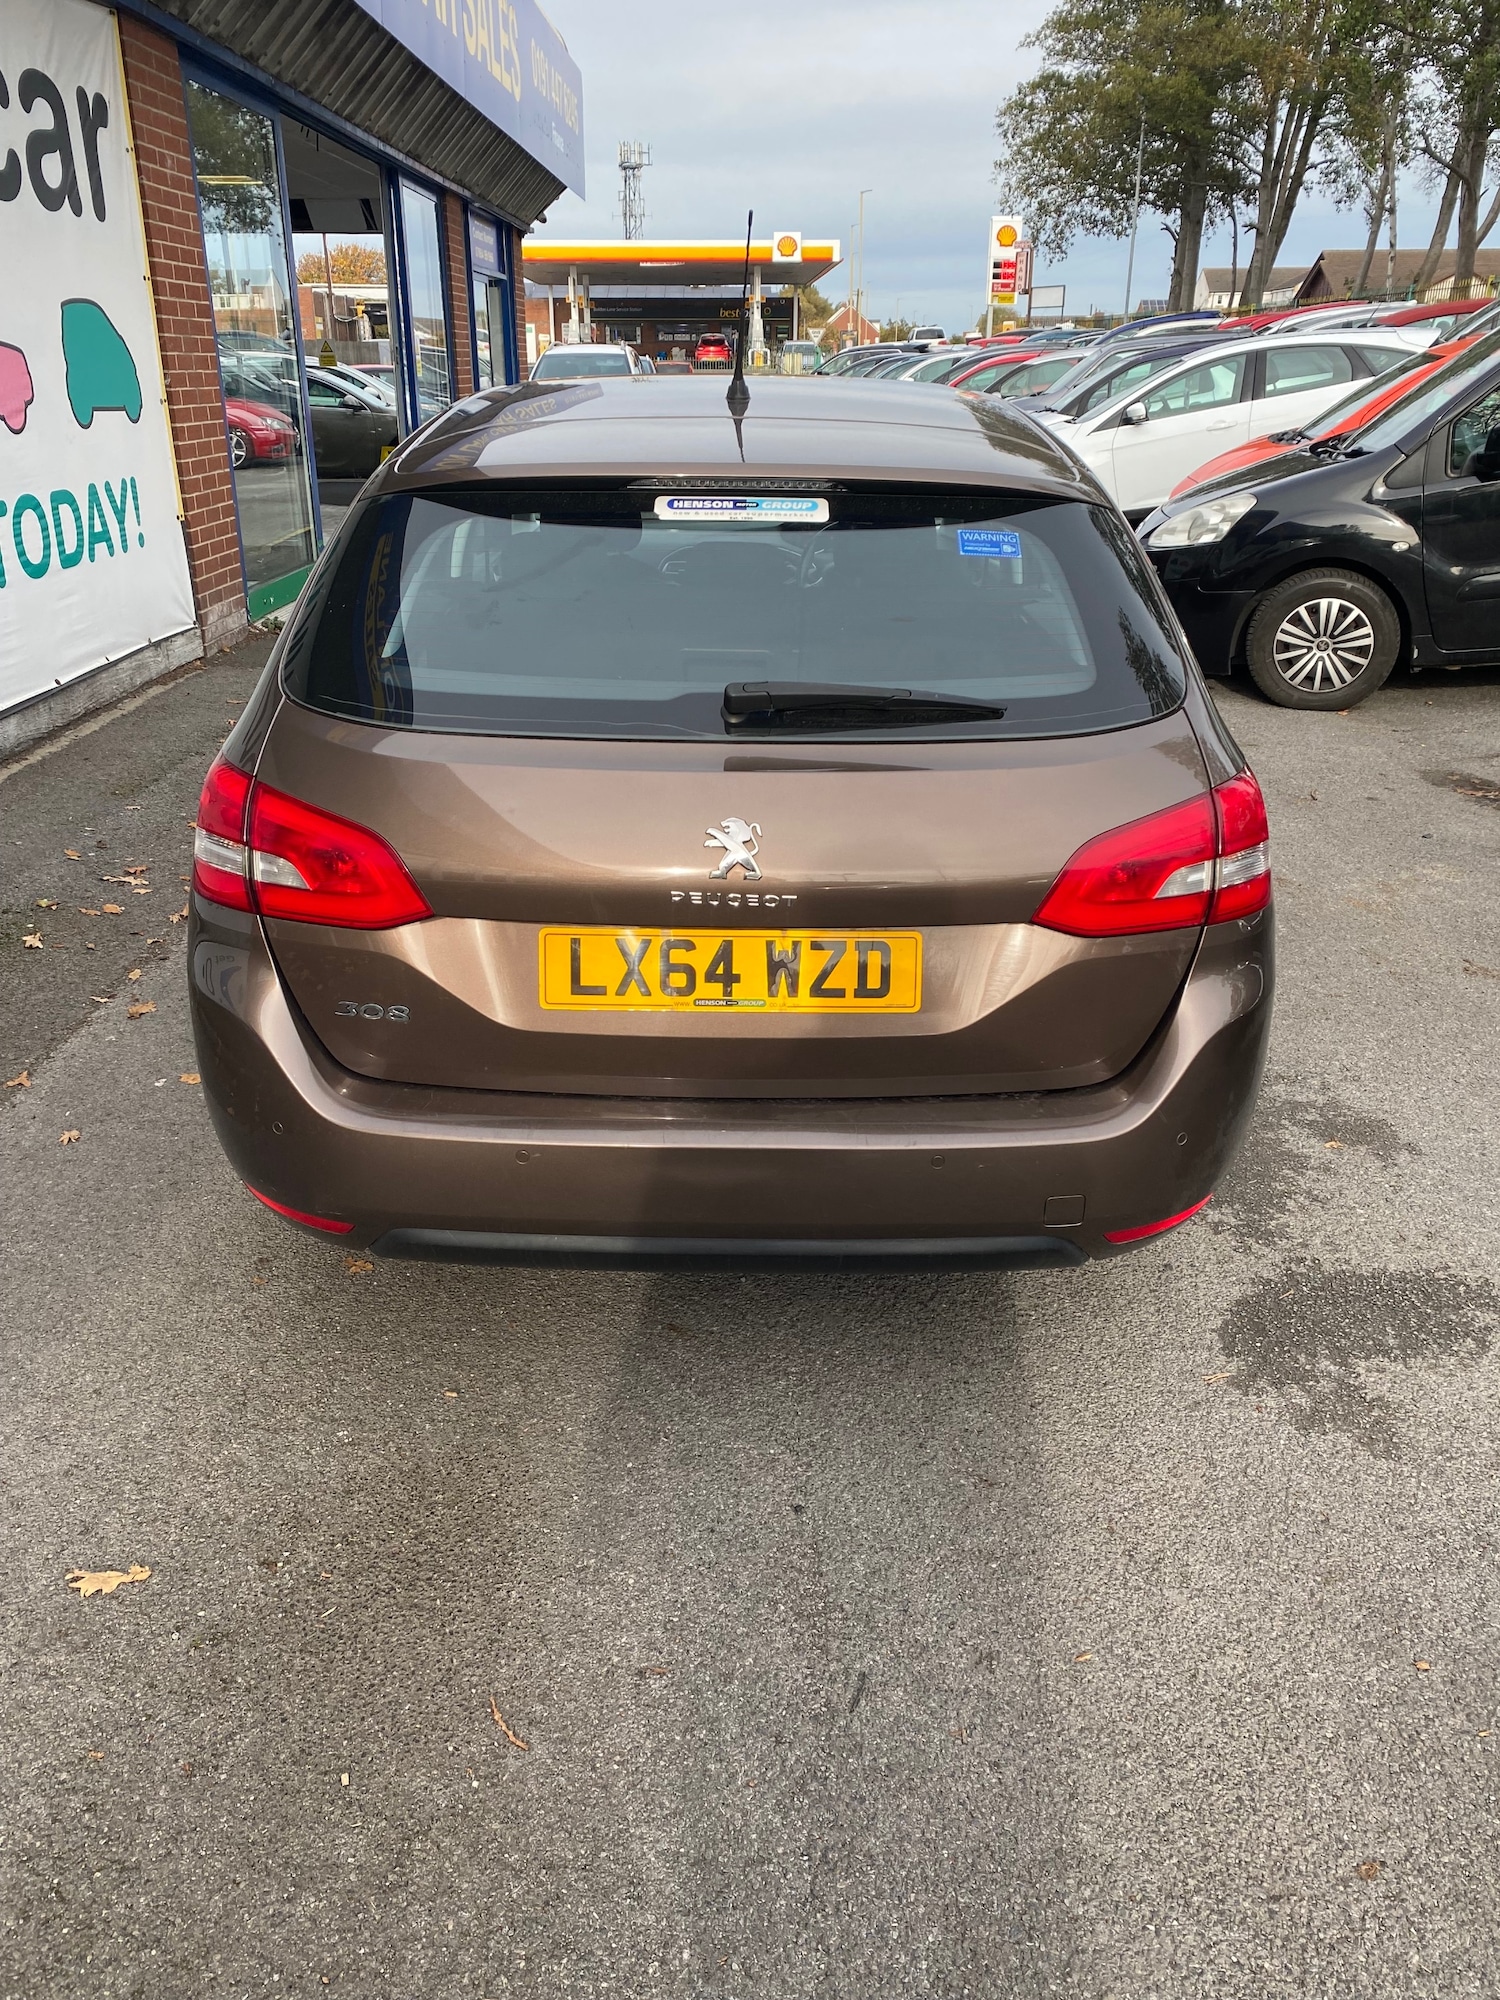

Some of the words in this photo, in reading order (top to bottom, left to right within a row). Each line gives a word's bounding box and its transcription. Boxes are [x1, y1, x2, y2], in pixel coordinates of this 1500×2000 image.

[673, 500, 734, 509] HENSON
[761, 501, 812, 510] GROUP
[962, 532, 1017, 543] WARNING
[670, 890, 798, 908] PEUGEOT
[569, 937, 741, 998] LX64
[766, 939, 893, 999] WZD
[334, 1000, 411, 1022] 308
